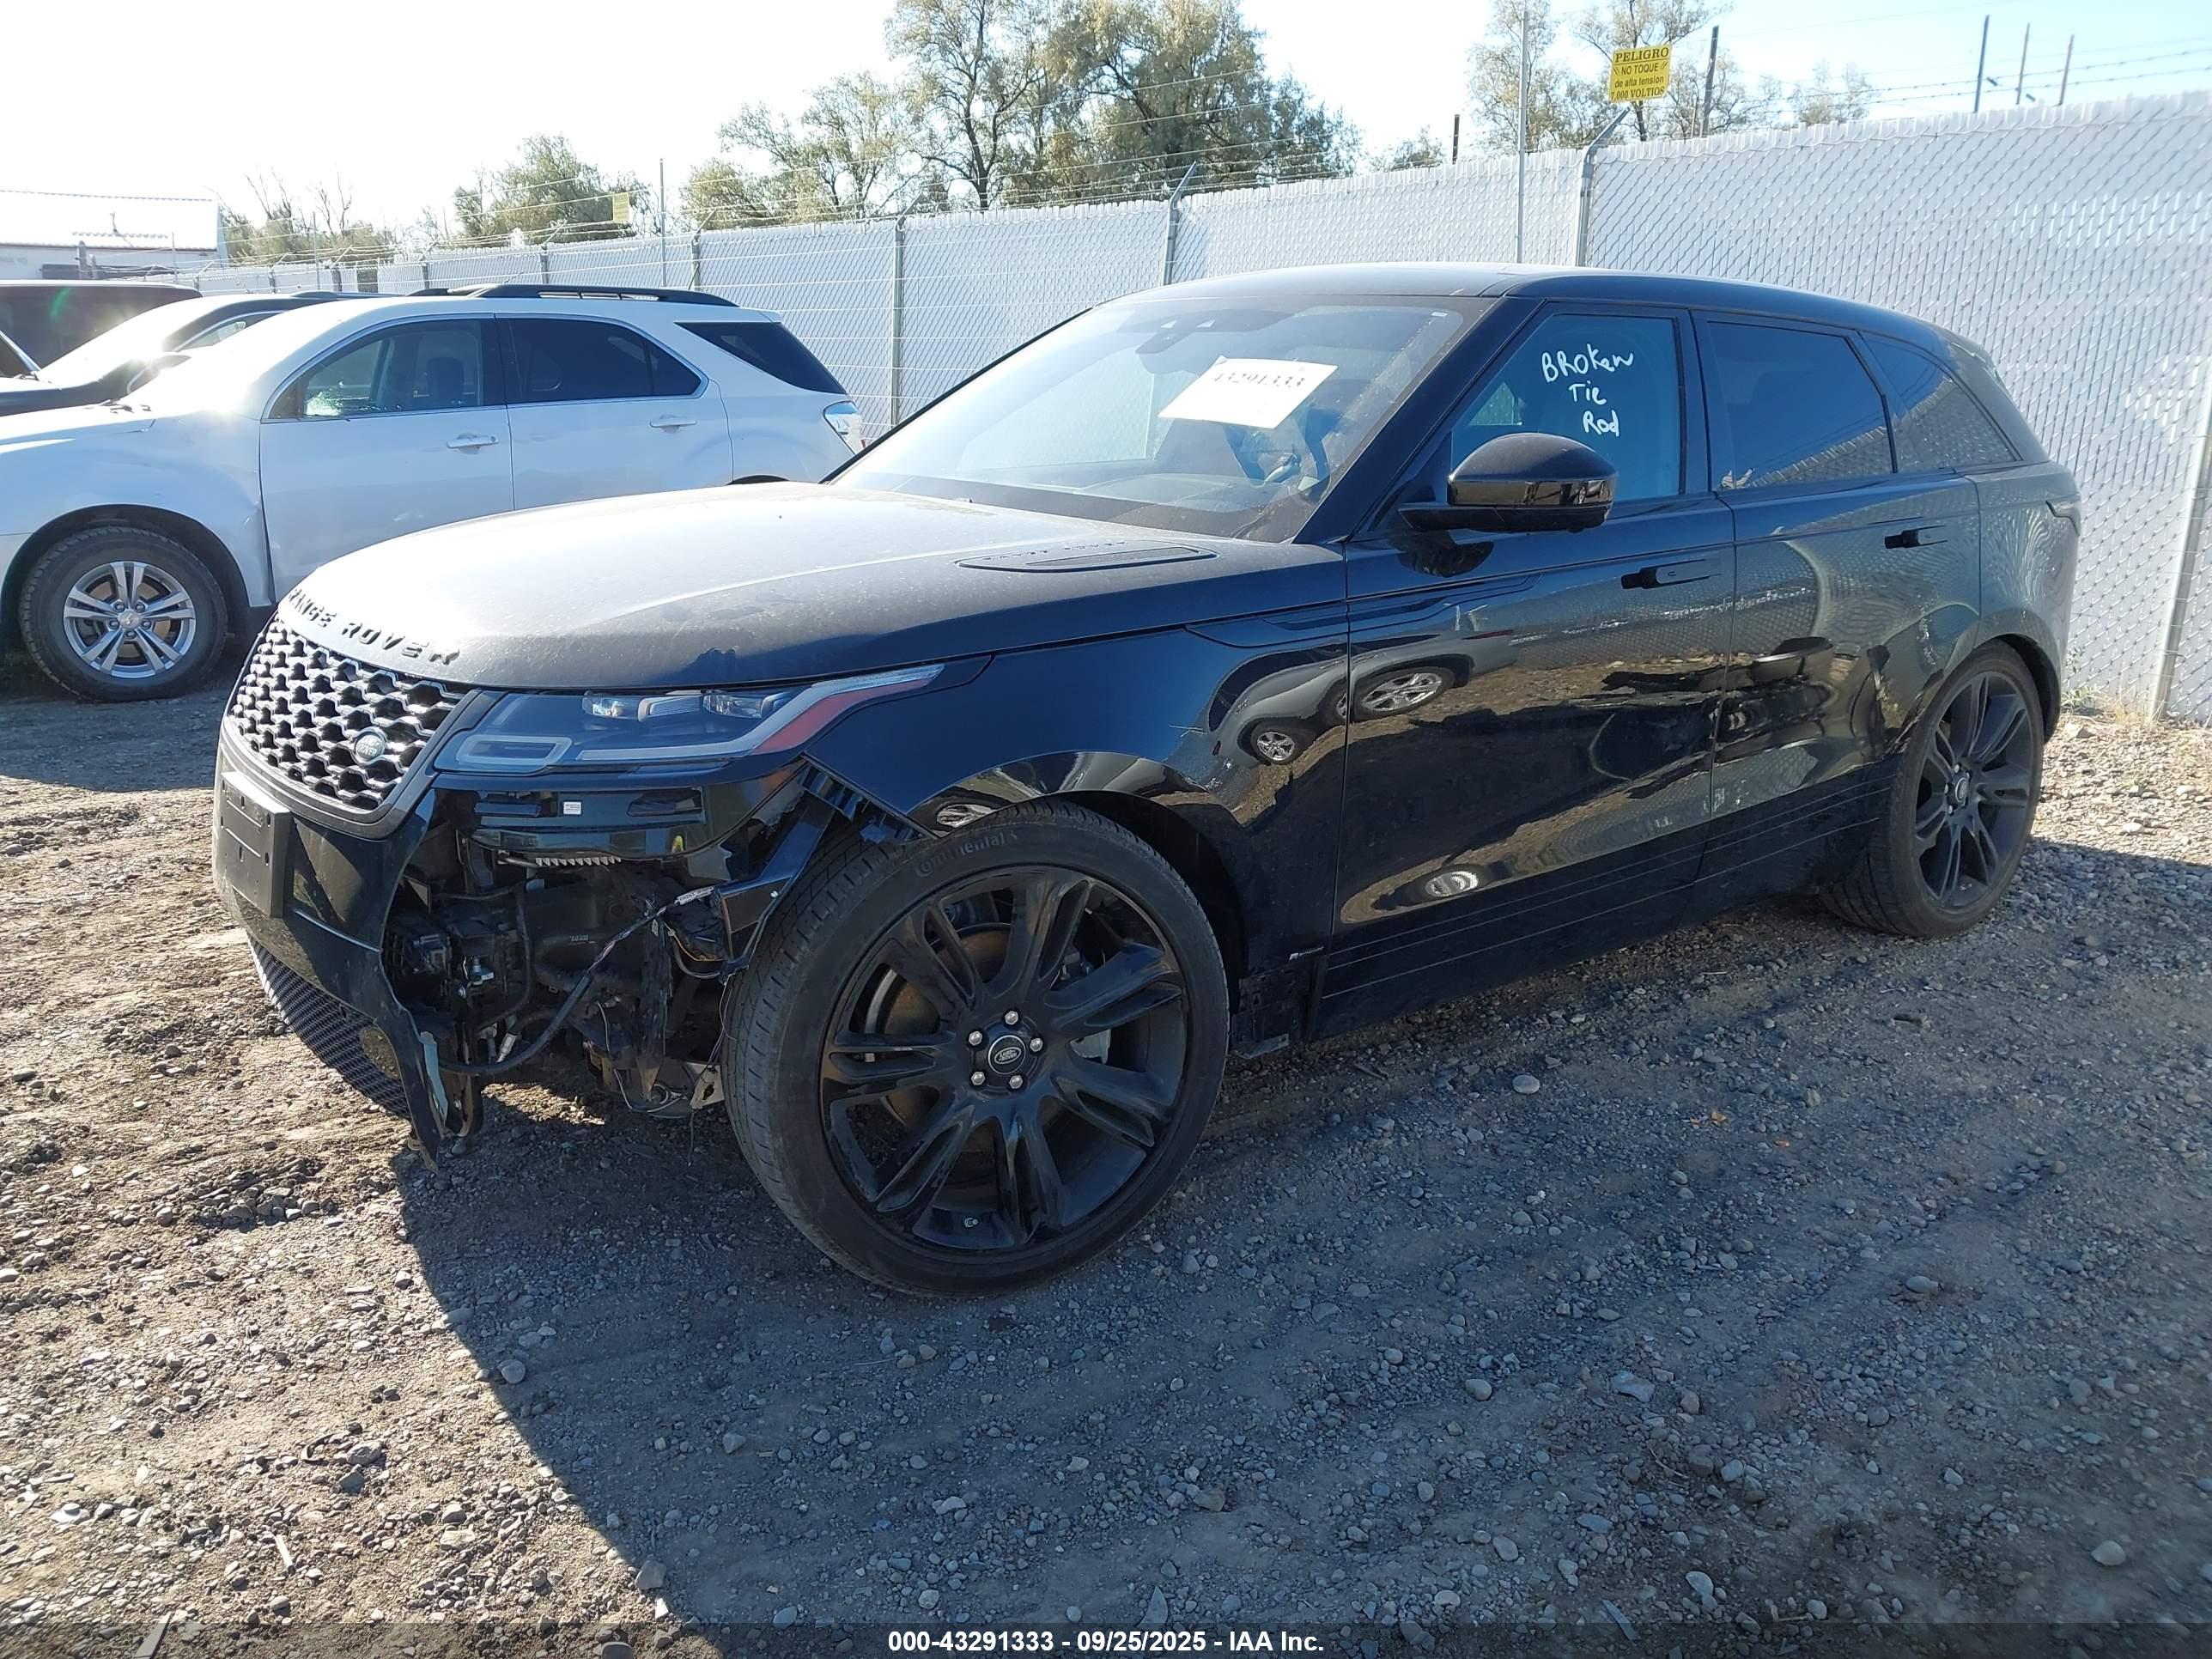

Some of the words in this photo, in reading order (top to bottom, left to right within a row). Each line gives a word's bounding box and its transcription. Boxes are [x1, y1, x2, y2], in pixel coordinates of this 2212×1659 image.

[1615, 47, 1669, 63] PELIGRO
[1621, 65, 1632, 76] NO
[1634, 63, 1659, 75] TOQUE
[1614, 78, 1624, 88] de
[1625, 77, 1638, 88] alta
[1630, 86, 1665, 99] VOLTIOS
[1583, 409, 1621, 438] Rod
[342, 621, 461, 666] ROVER
